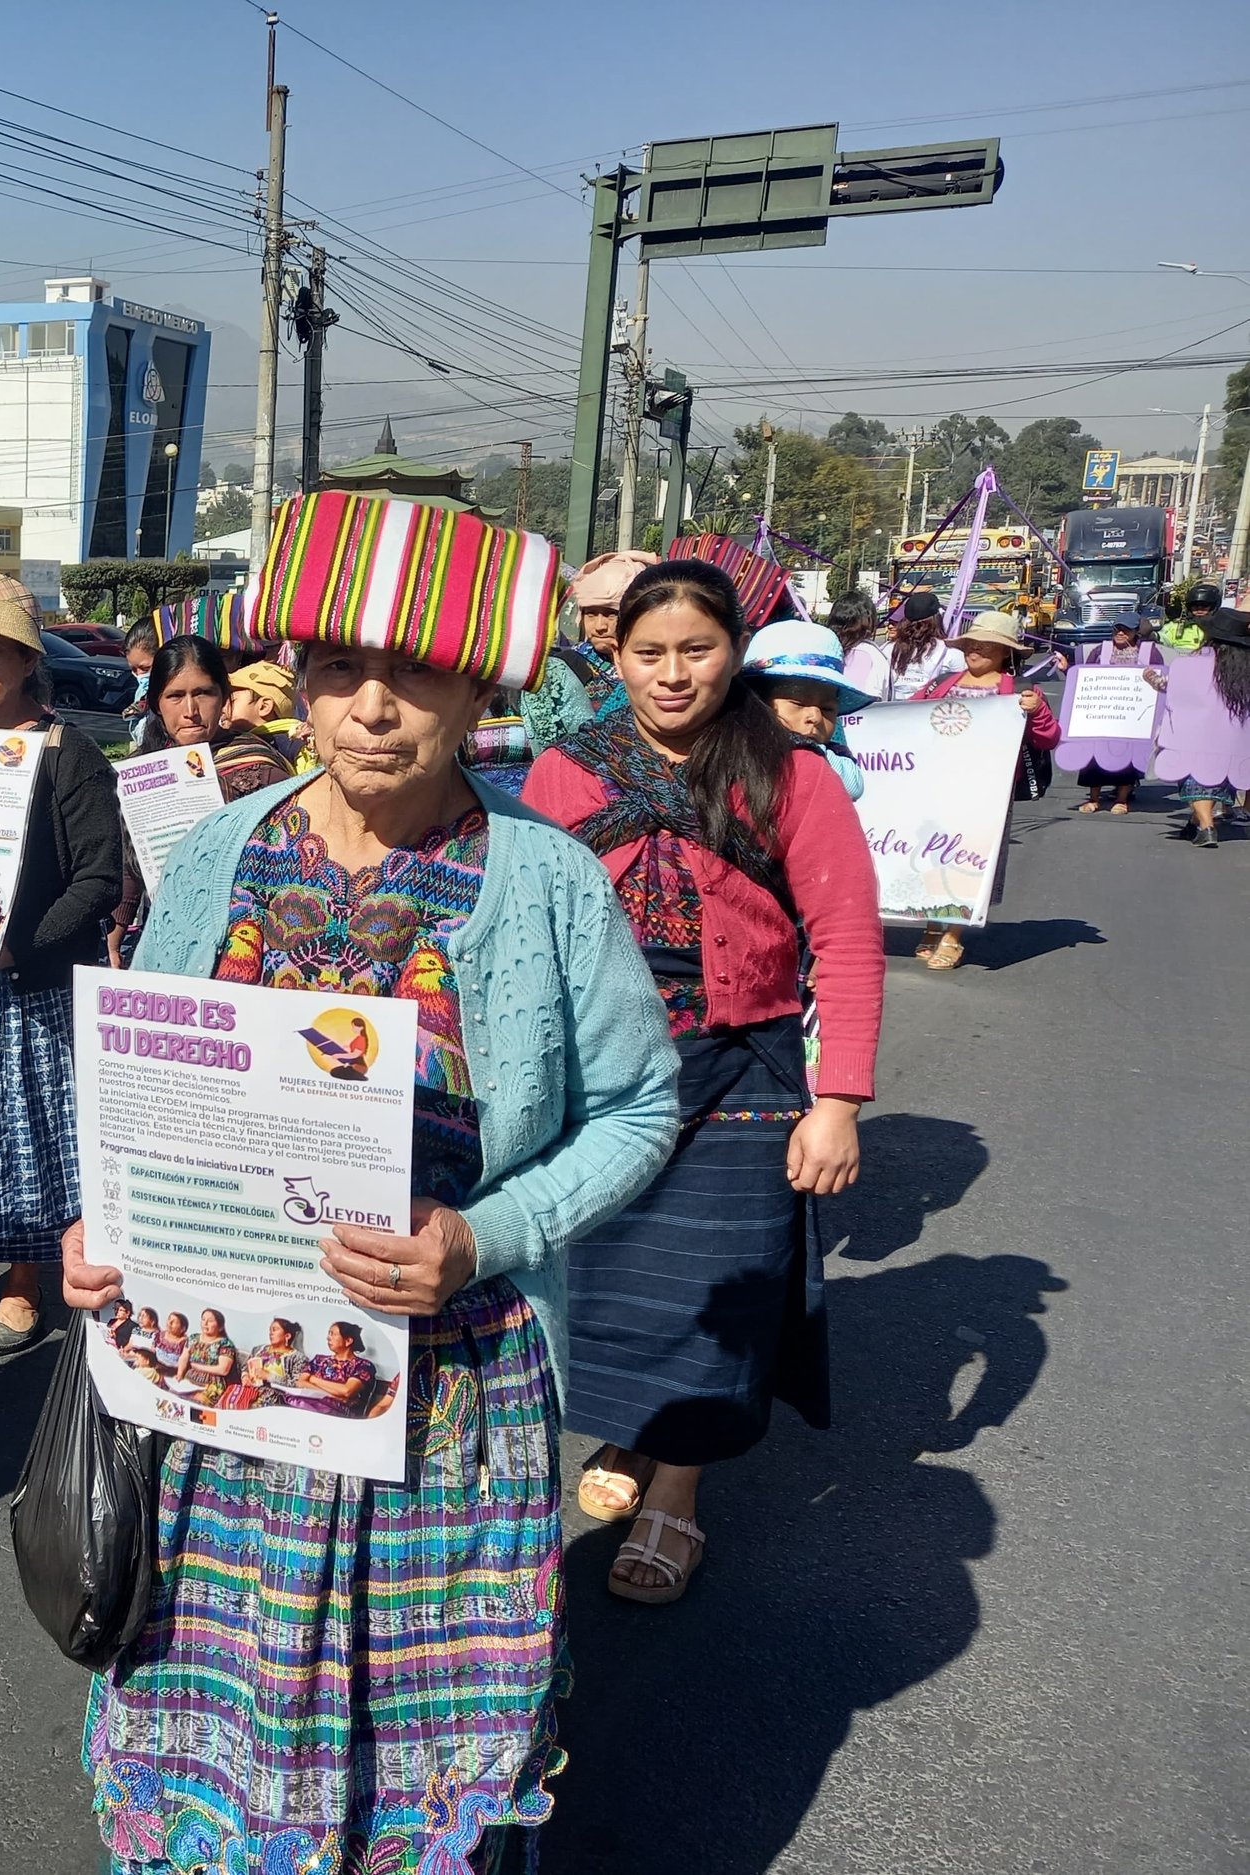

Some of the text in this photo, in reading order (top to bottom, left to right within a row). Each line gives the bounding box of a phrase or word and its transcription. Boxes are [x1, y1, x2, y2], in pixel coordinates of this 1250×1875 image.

[842, 716, 863, 727] jer
[865, 828, 912, 855] ida
[98, 986, 236, 1032] DECIDIR ES
[97, 1022, 251, 1072] TU DERECHO
[99, 1058, 241, 1088] Como mujeres K'iche's, tenemos
[99, 1067, 247, 1097] derecho tomar decisiones sobre
[280, 1076, 404, 1097] MUJERES TEJIENDO CAMINOS
[99, 1077, 232, 1104] nuestros recursos económicos.
[307, 1088, 338, 1097] DEFENSA
[365, 1095, 402, 1106] DERECHOS
[99, 1086, 350, 1132] La iniciativa LEYDEM impulsa programas que fortalecen
[99, 1096, 371, 1143] autonomía económica las mujeres, brindándonos acceso
[99, 1105, 392, 1155] capacitación, asistencia técnica, financiamiento para proyectos
[100, 1130, 136, 1142] recursos.
[100, 1113, 386, 1162] productivos. Este paso clave para que las mujeres puedan
[100, 1121, 406, 1175] alcanzar independencia económica control sobre sus propios
[100, 1140, 274, 1176] Programas clave iniciativa LEYDEM
[130, 1167, 239, 1191] CAPACITACIÓN Y FORMACIÓN
[131, 1191, 276, 1218] ASISTENCIA TÉCNICA Y TECNOLÓGICA
[326, 1206, 391, 1227] LEYDEM
[132, 1214, 161, 1226] ACCESO
[162, 1219, 168, 1227] A
[169, 1220, 235, 1237] FINANCIAMIENTO
[236, 1230, 242, 1238] Y
[243, 1230, 277, 1242] COMPRA
[278, 1235, 289, 1243] DE
[132, 1237, 314, 1269] MI PRIMER TRABAJO, UNA NUEVA OPORTUNIDAD
[121, 1253, 154, 1267] Mujeres
[155, 1262, 219, 1280] empoderadas,
[220, 1272, 258, 1283] generan
[260, 1276, 296, 1288] familias
[123, 1263, 131, 1272] El
[133, 1266, 174, 1281] desarrollo
[176, 1276, 226, 1289] económico
[227, 1281, 240, 1290] de
[241, 1283, 254, 1292] las
[256, 1287, 294, 1298] mujeres
